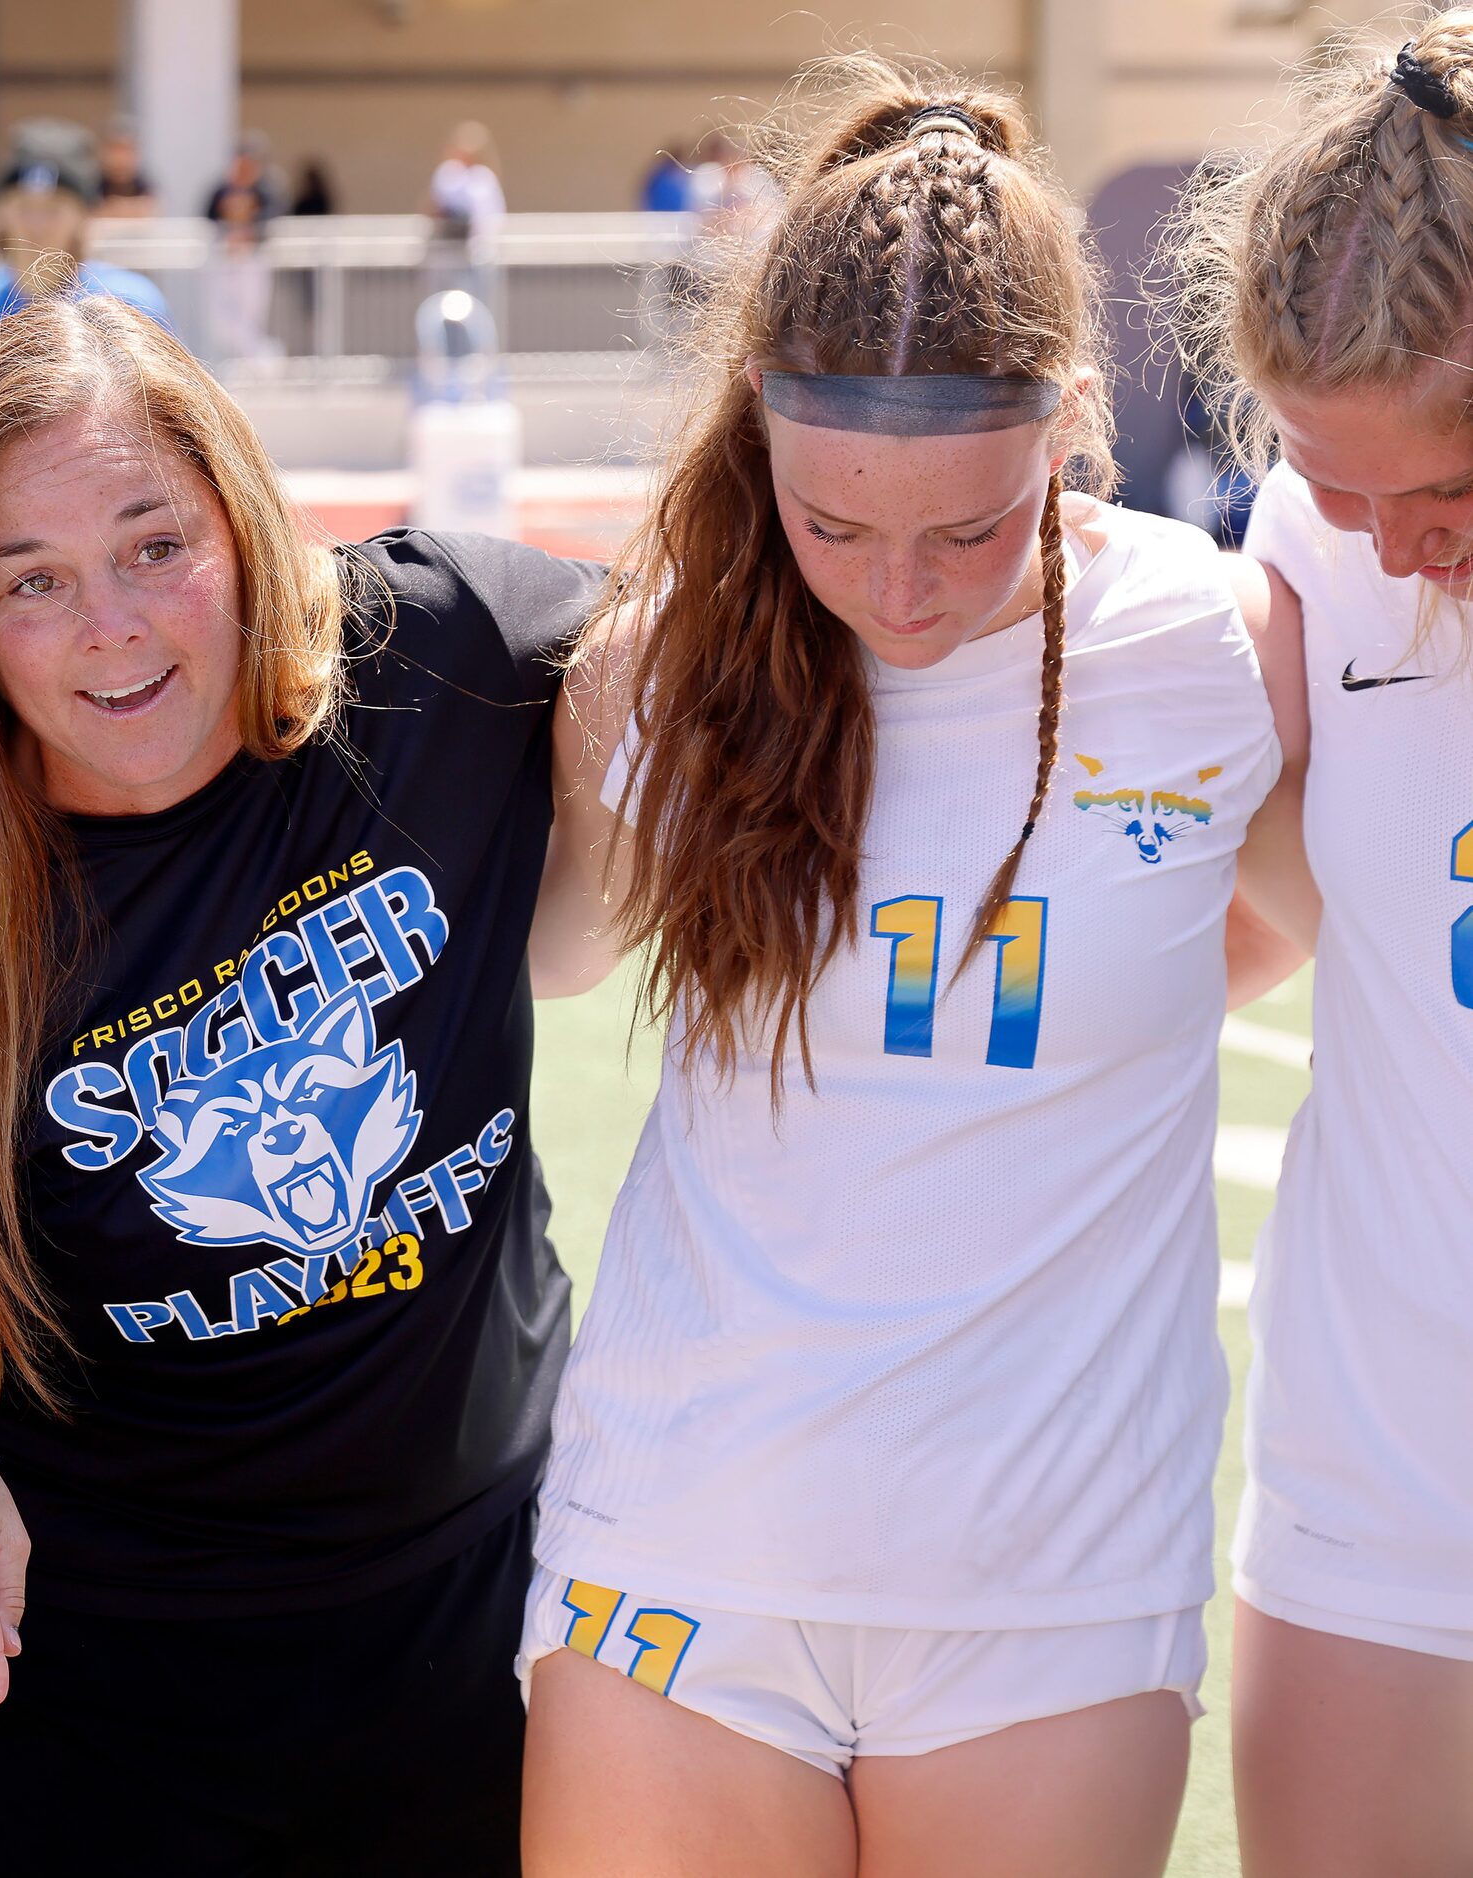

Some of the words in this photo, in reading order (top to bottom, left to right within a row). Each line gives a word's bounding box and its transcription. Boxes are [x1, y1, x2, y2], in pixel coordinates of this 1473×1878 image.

[45, 865, 450, 1172] SOCCER
[73, 977, 204, 1057] FRISCO
[212, 849, 375, 985] RACOONS
[870, 894, 1049, 1070] 11
[276, 1233, 424, 1326] 23
[560, 1578, 702, 1698] 11
